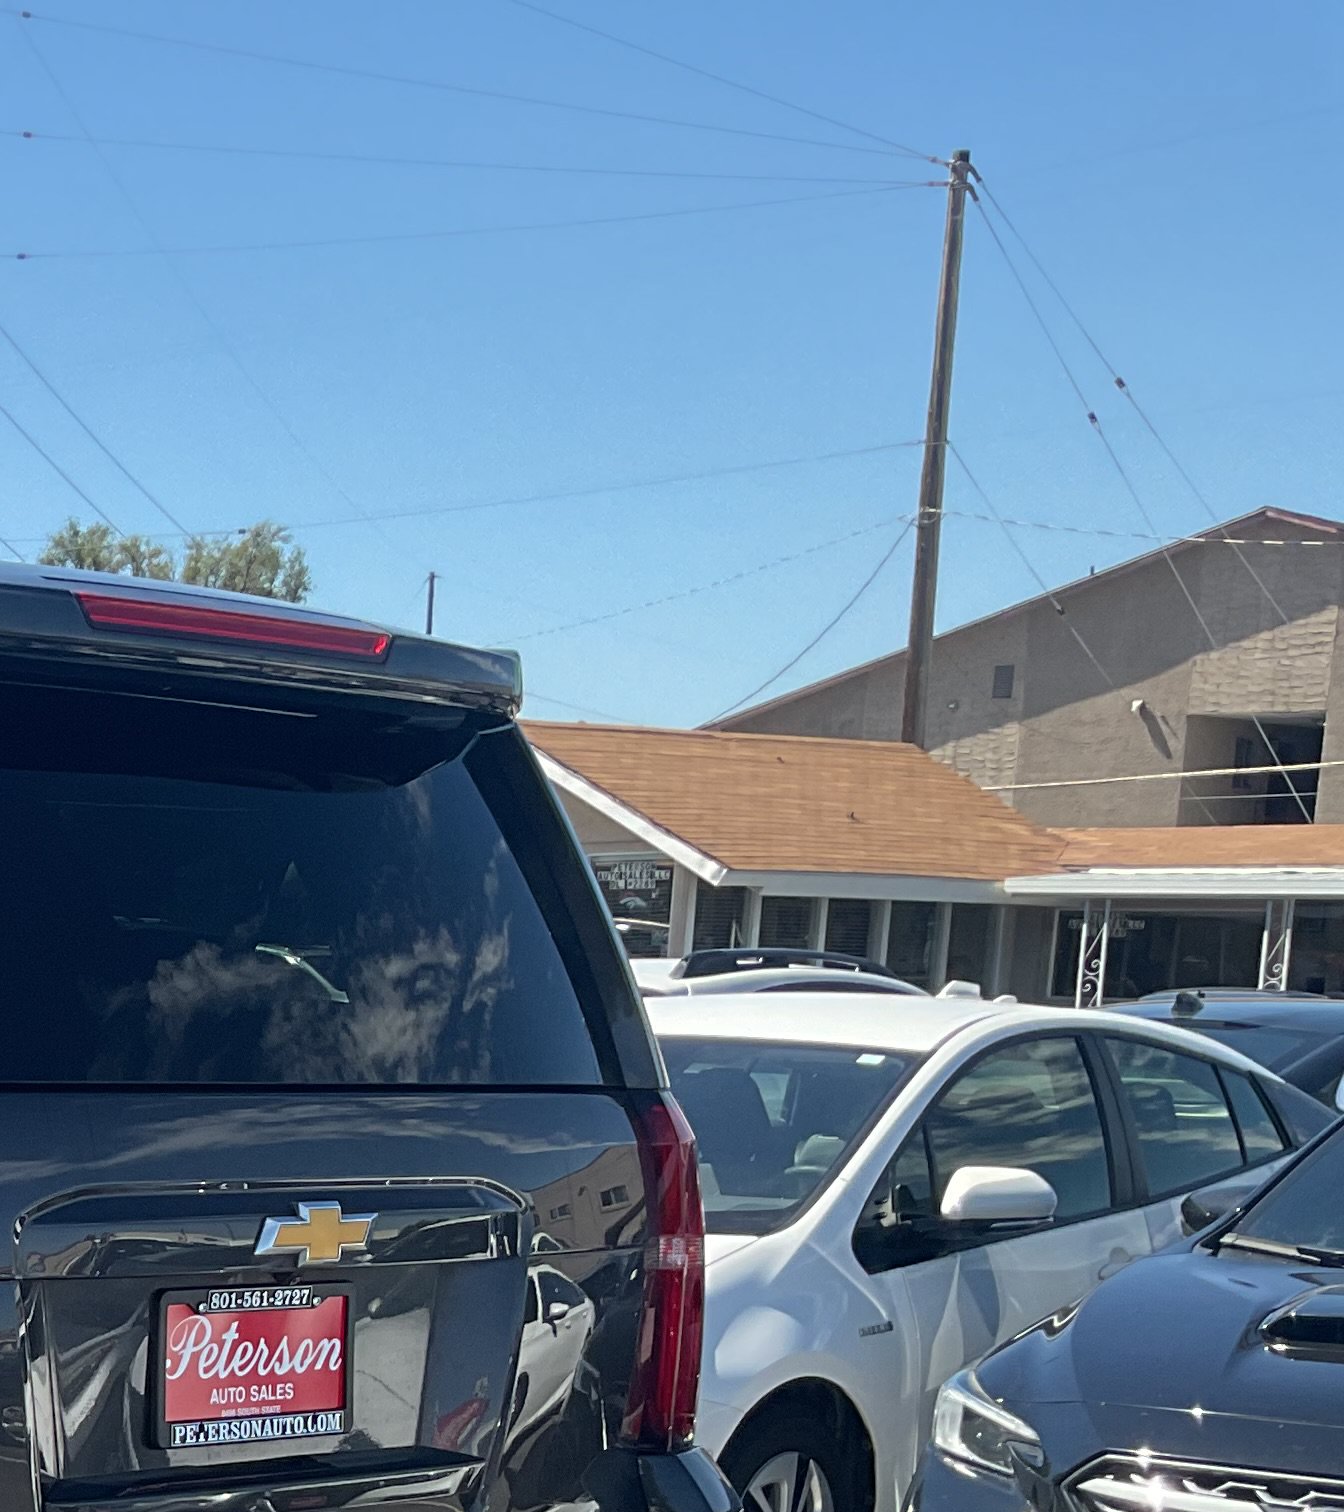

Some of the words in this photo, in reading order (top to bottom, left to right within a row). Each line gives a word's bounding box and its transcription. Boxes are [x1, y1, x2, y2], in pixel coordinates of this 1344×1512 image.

[210, 1289, 310, 1309] 801-561-2727
[166, 1315, 343, 1379] Peterson
[210, 1387, 246, 1404] AUTO
[250, 1383, 294, 1402] SALES
